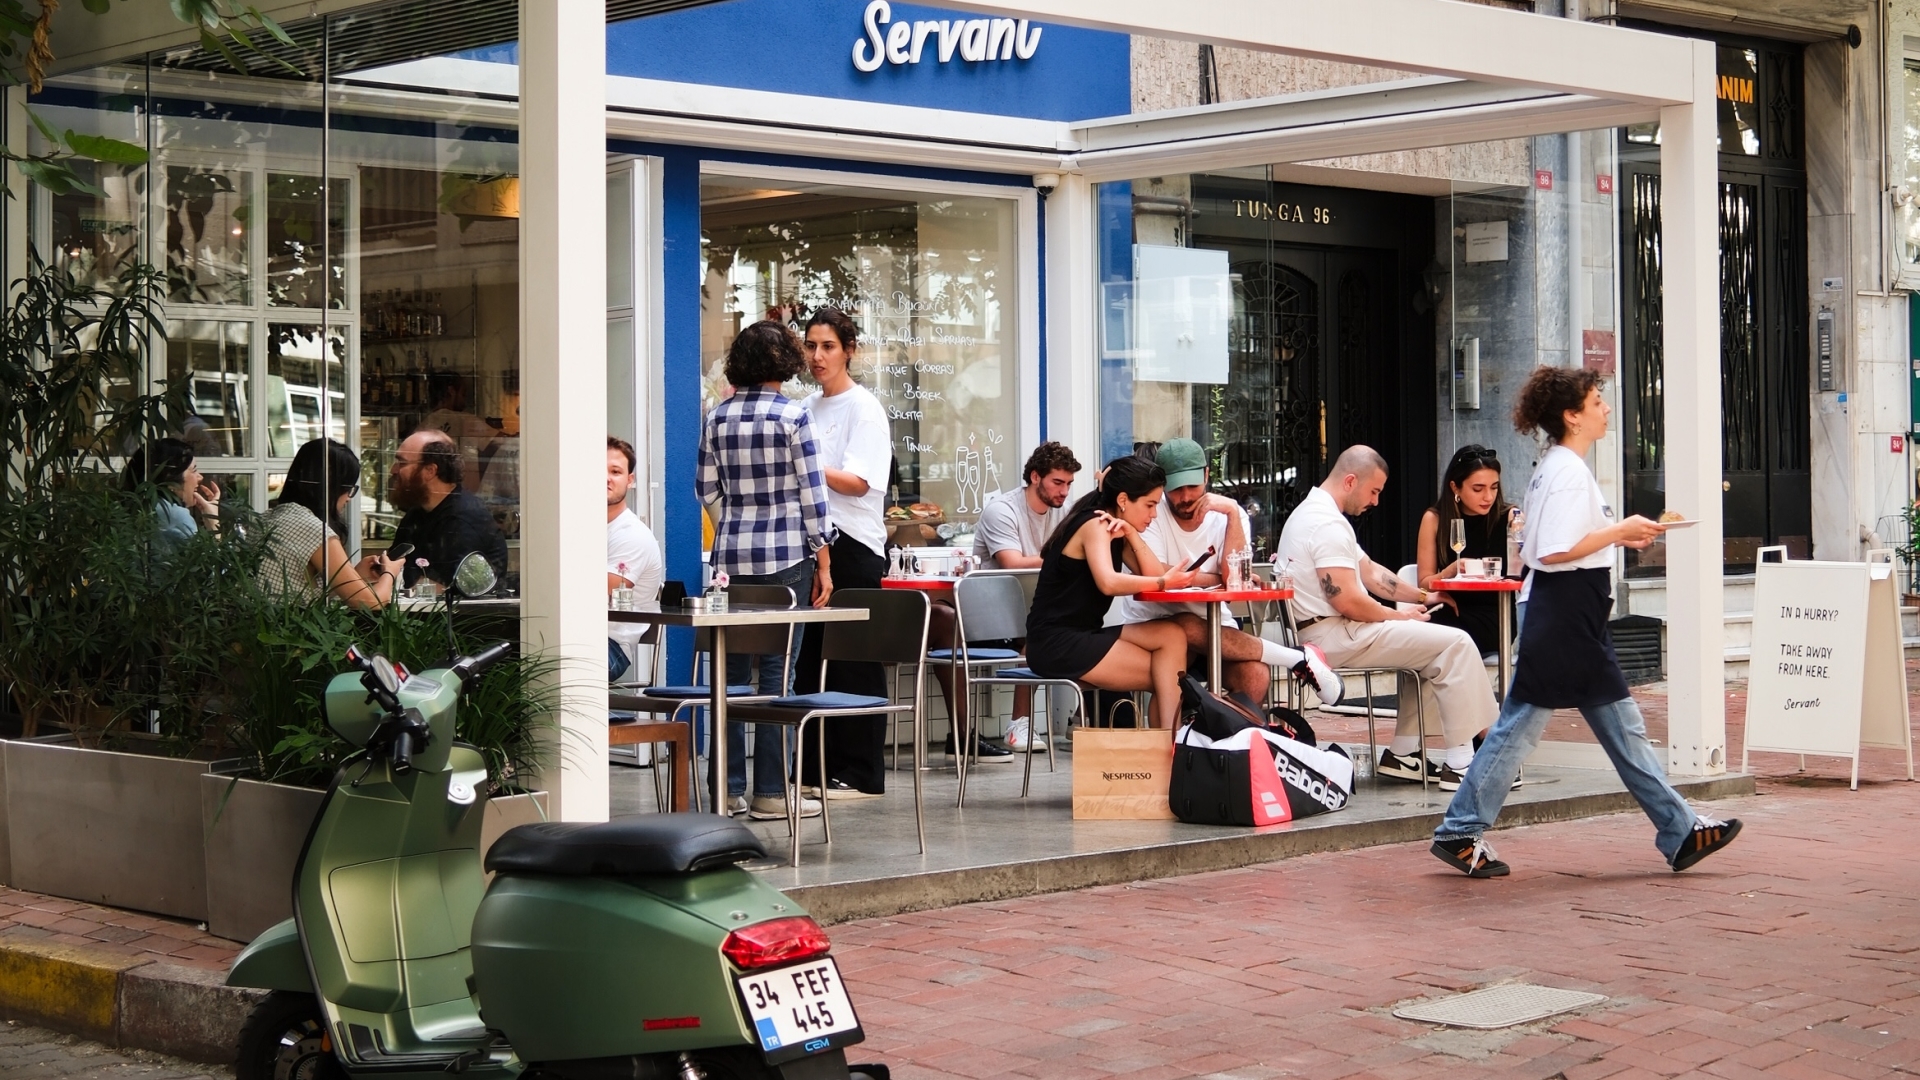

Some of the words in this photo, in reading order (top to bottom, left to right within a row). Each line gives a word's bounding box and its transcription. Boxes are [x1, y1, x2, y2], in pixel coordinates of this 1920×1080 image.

[1540, 175, 1549, 185] 98
[1232, 199, 1304, 223] TUNGA
[1313, 207, 1330, 224] 96
[903, 382, 945, 402] BÖREK
[887, 405, 924, 421] SALATA
[1781, 606, 1793, 619] IN
[1795, 607, 1801, 619] A
[1804, 608, 1839, 621] HURRY?
[1780, 644, 1803, 657] TAKE
[1806, 646, 1833, 660] AWAY
[1778, 662, 1802, 676] FROM
[1805, 665, 1831, 679] HERE.
[1784, 697, 1821, 711] Servant
[1102, 771, 1152, 782] NESPRESSO
[1275, 751, 1346, 811] Babolat
[749, 980, 780, 1009] 34
[791, 966, 831, 999] FEF
[792, 1000, 835, 1033] 445
[766, 1036, 780, 1047] TR
